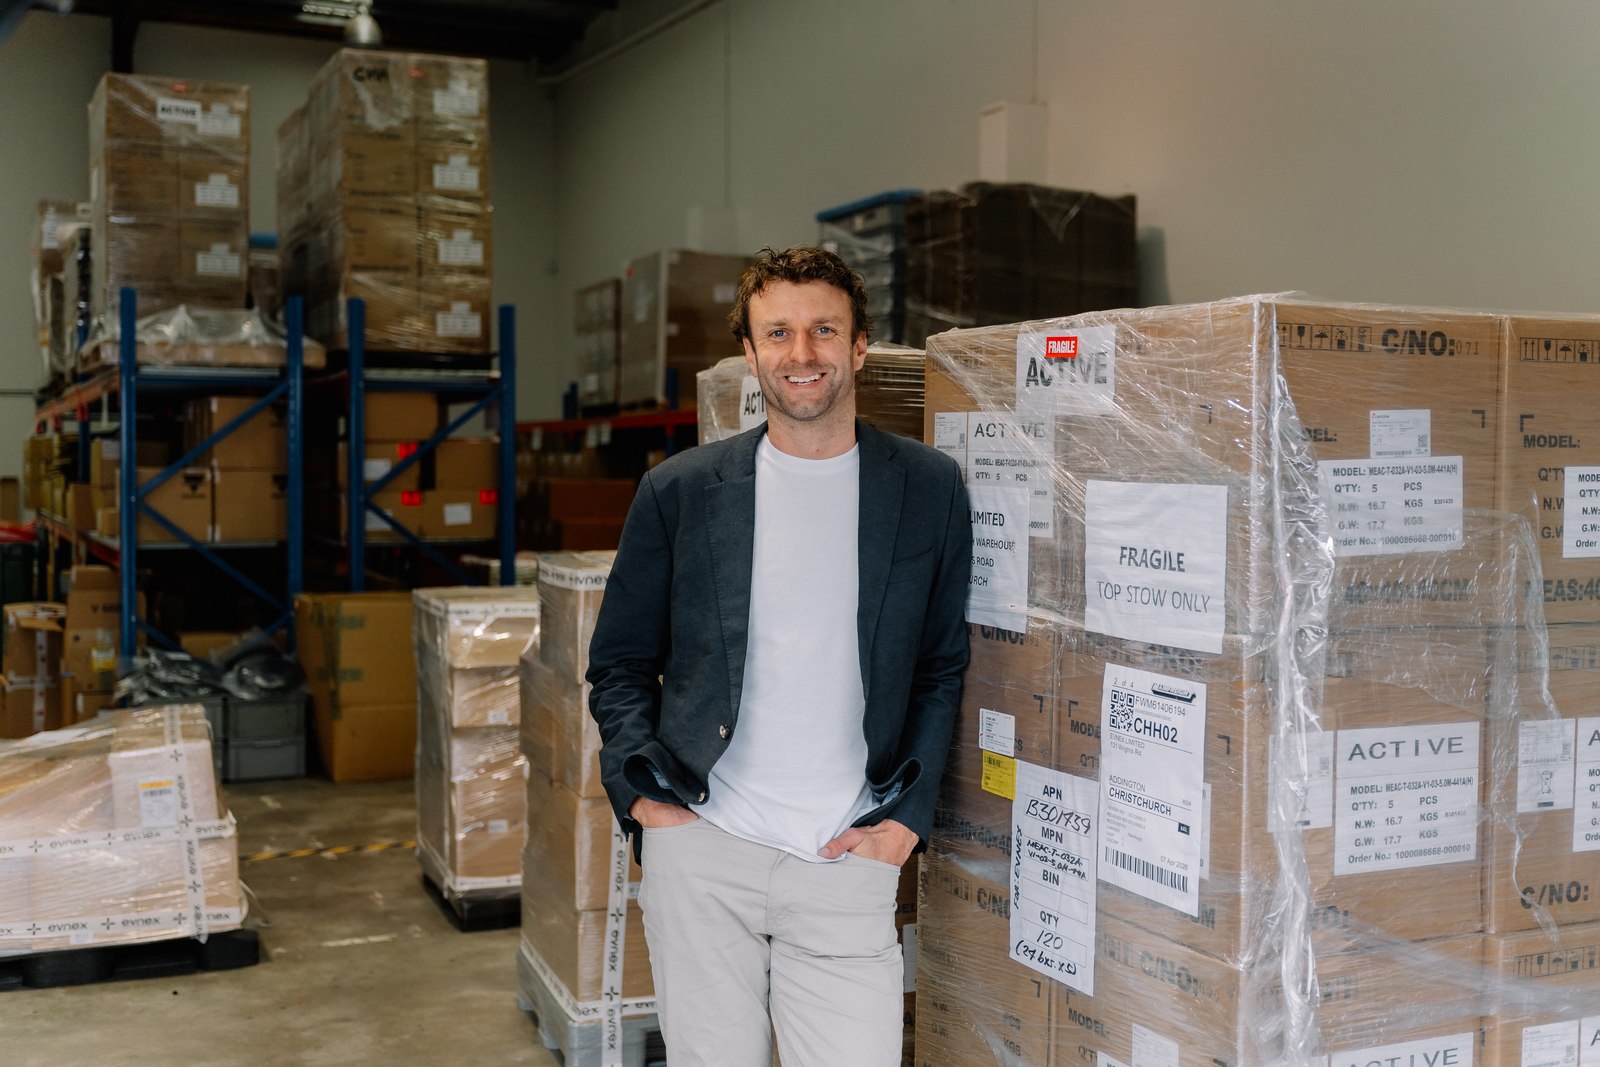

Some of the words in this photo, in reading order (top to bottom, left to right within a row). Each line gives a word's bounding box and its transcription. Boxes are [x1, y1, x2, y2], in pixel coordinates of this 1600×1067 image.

[1048, 340, 1076, 354] FRAGILE
[1382, 328, 1455, 356] C/NO:
[974, 422, 1045, 438] ACTVE
[1523, 434, 1581, 448] MODEL:
[996, 473, 1001, 481] 5
[1015, 473, 1028, 482] PCS
[1333, 467, 1366, 477] MODEL:
[1334, 483, 1361, 493] Q'TY:
[1371, 483, 1378, 493] 5
[1403, 481, 1423, 492] PCS
[1367, 500, 1386, 511] 16.7
[1404, 498, 1424, 508] KGS
[1338, 520, 1360, 530] G.W:
[1367, 520, 1386, 530] 17.7
[1403, 516, 1424, 526] KGS
[1576, 539, 1597, 548] Order
[976, 557, 995, 567] ROAD
[1119, 546, 1186, 573] FRAGILE
[1097, 581, 1121, 600] TOP
[1127, 585, 1167, 607] STOW
[1171, 591, 1210, 613] ONLY
[1134, 717, 1178, 743] CHH02
[1348, 736, 1464, 761] ACTIVE
[1109, 774, 1146, 792] ADDINGTON
[1350, 785, 1383, 795] MODEL:
[1042, 784, 1063, 801] APN
[1109, 787, 1172, 816] CHRISTCHURCH
[1351, 800, 1378, 811] Q'TY:
[1388, 800, 1394, 809] 5
[1419, 795, 1438, 805] PCS
[1025, 799, 1091, 834] B301439
[1355, 820, 1376, 830] N.W:
[1385, 816, 1403, 826] 16.7
[1419, 811, 1439, 822] KGS
[1041, 826, 1063, 844] MPN
[1354, 837, 1375, 847] G.W:
[1384, 836, 1402, 845] 17.7
[1419, 829, 1439, 839] KGS
[1348, 853, 1372, 864] Order
[1375, 852, 1391, 861] No.:
[615, 850, 626, 893] evnex
[1042, 869, 1060, 886] BIN
[1520, 881, 1589, 909] C/NO:
[48, 921, 88, 932] evnex
[121, 917, 161, 927] evnex
[206, 912, 231, 921] nex
[1040, 910, 1059, 928] QTY
[1036, 930, 1064, 950] 120
[609, 930, 620, 972] evnex
[607, 1008, 617, 1050] evnex
[1350, 1047, 1459, 1067] TIVE
